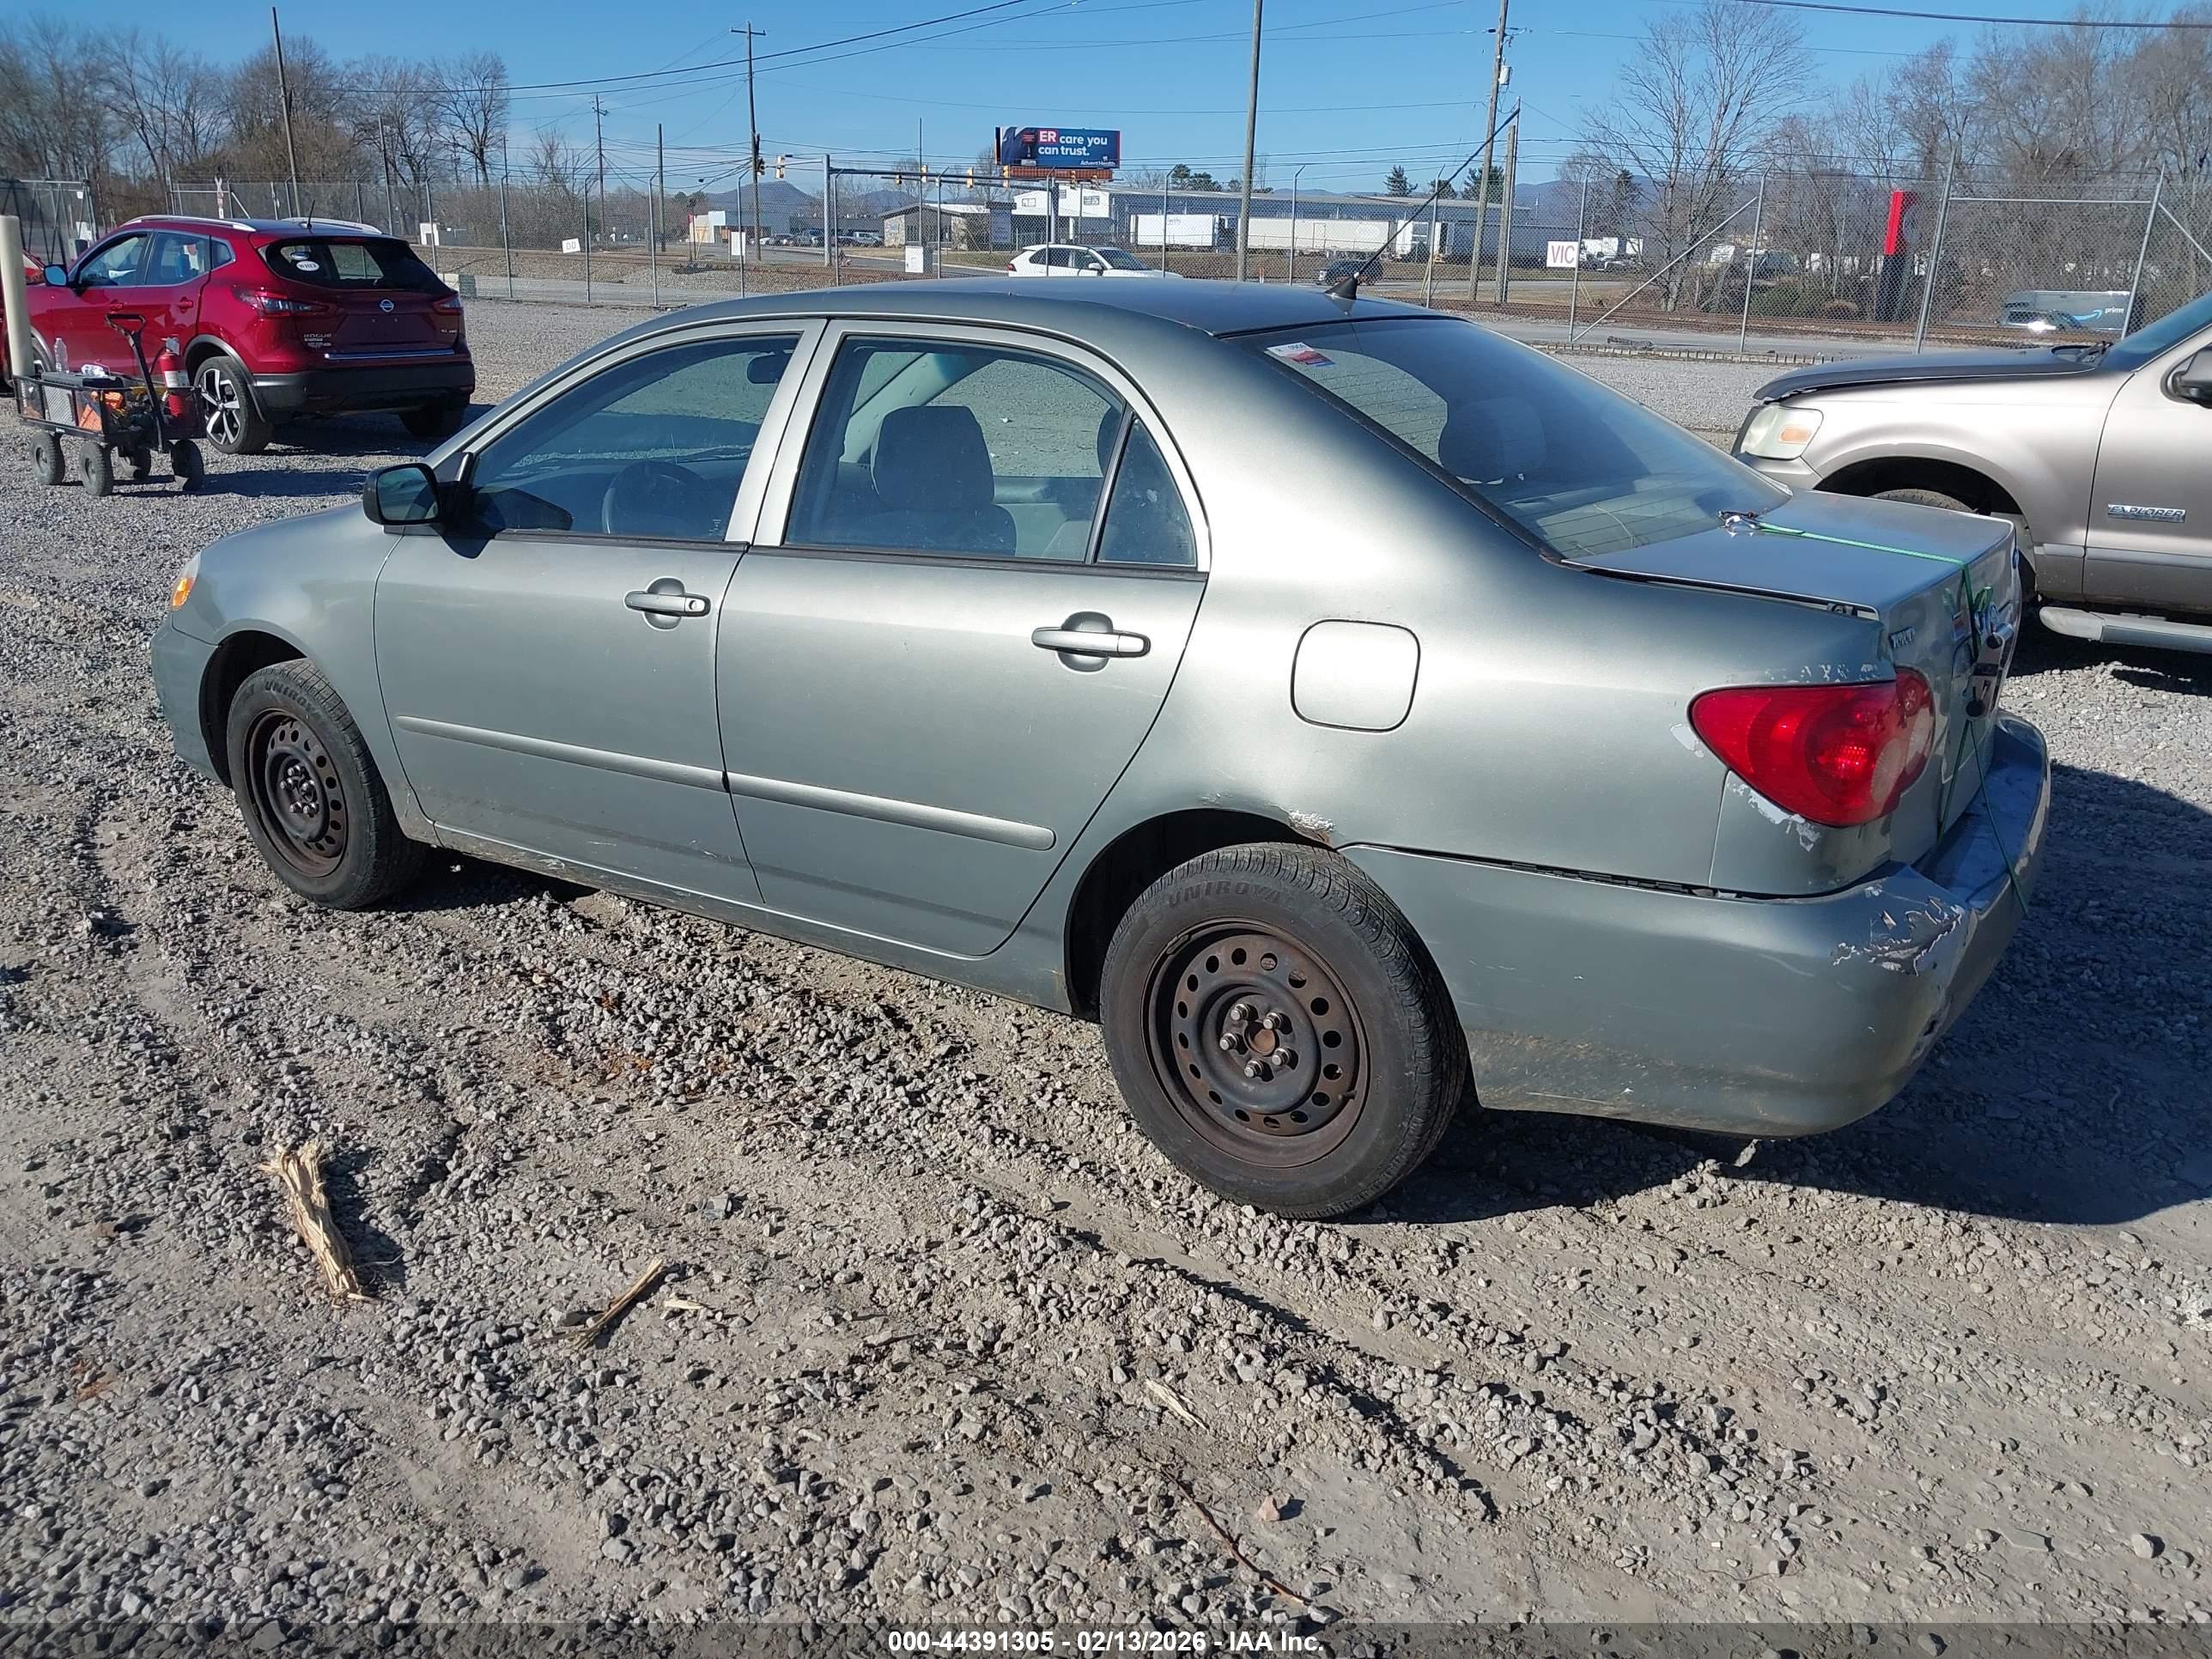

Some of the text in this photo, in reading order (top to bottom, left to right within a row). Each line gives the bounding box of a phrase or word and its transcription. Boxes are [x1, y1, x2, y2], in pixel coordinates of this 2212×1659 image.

[1039, 131, 1057, 143] ER
[1059, 135, 1085, 145] care
[1087, 136, 1108, 148] you
[1038, 145, 1091, 156] can trust.
[1551, 245, 1575, 264] VIC
[2108, 505, 2185, 519] EXPLORER
